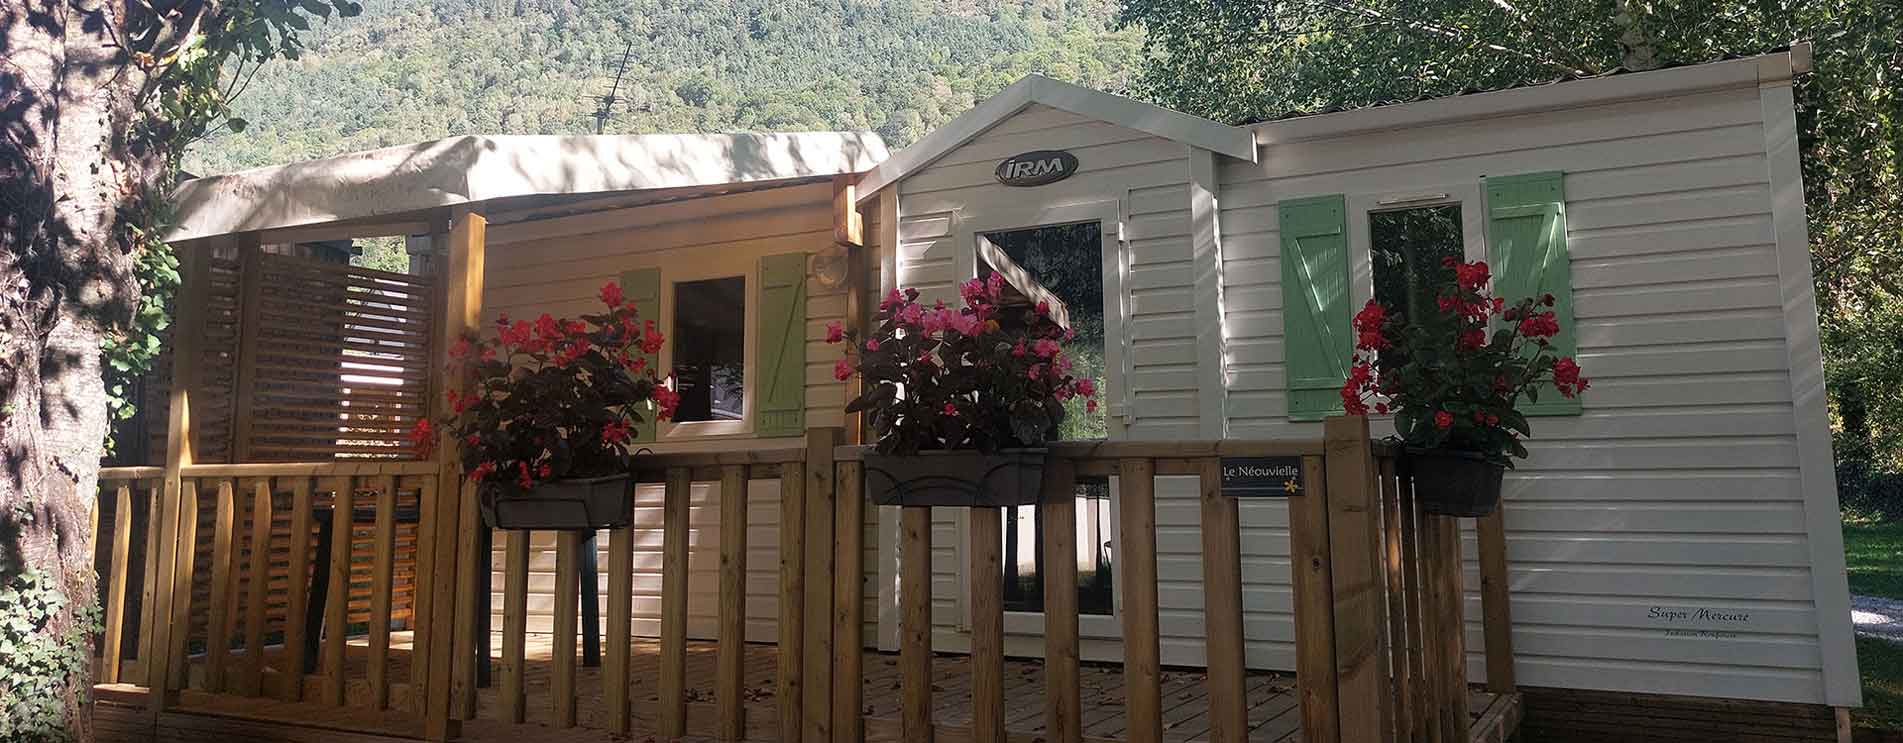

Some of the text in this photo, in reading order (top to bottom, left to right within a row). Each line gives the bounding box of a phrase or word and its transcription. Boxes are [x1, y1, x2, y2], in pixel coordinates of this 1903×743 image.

[1223, 464, 1299, 477] Le Néouvielle
[1647, 607, 1750, 622] Super Mercure
